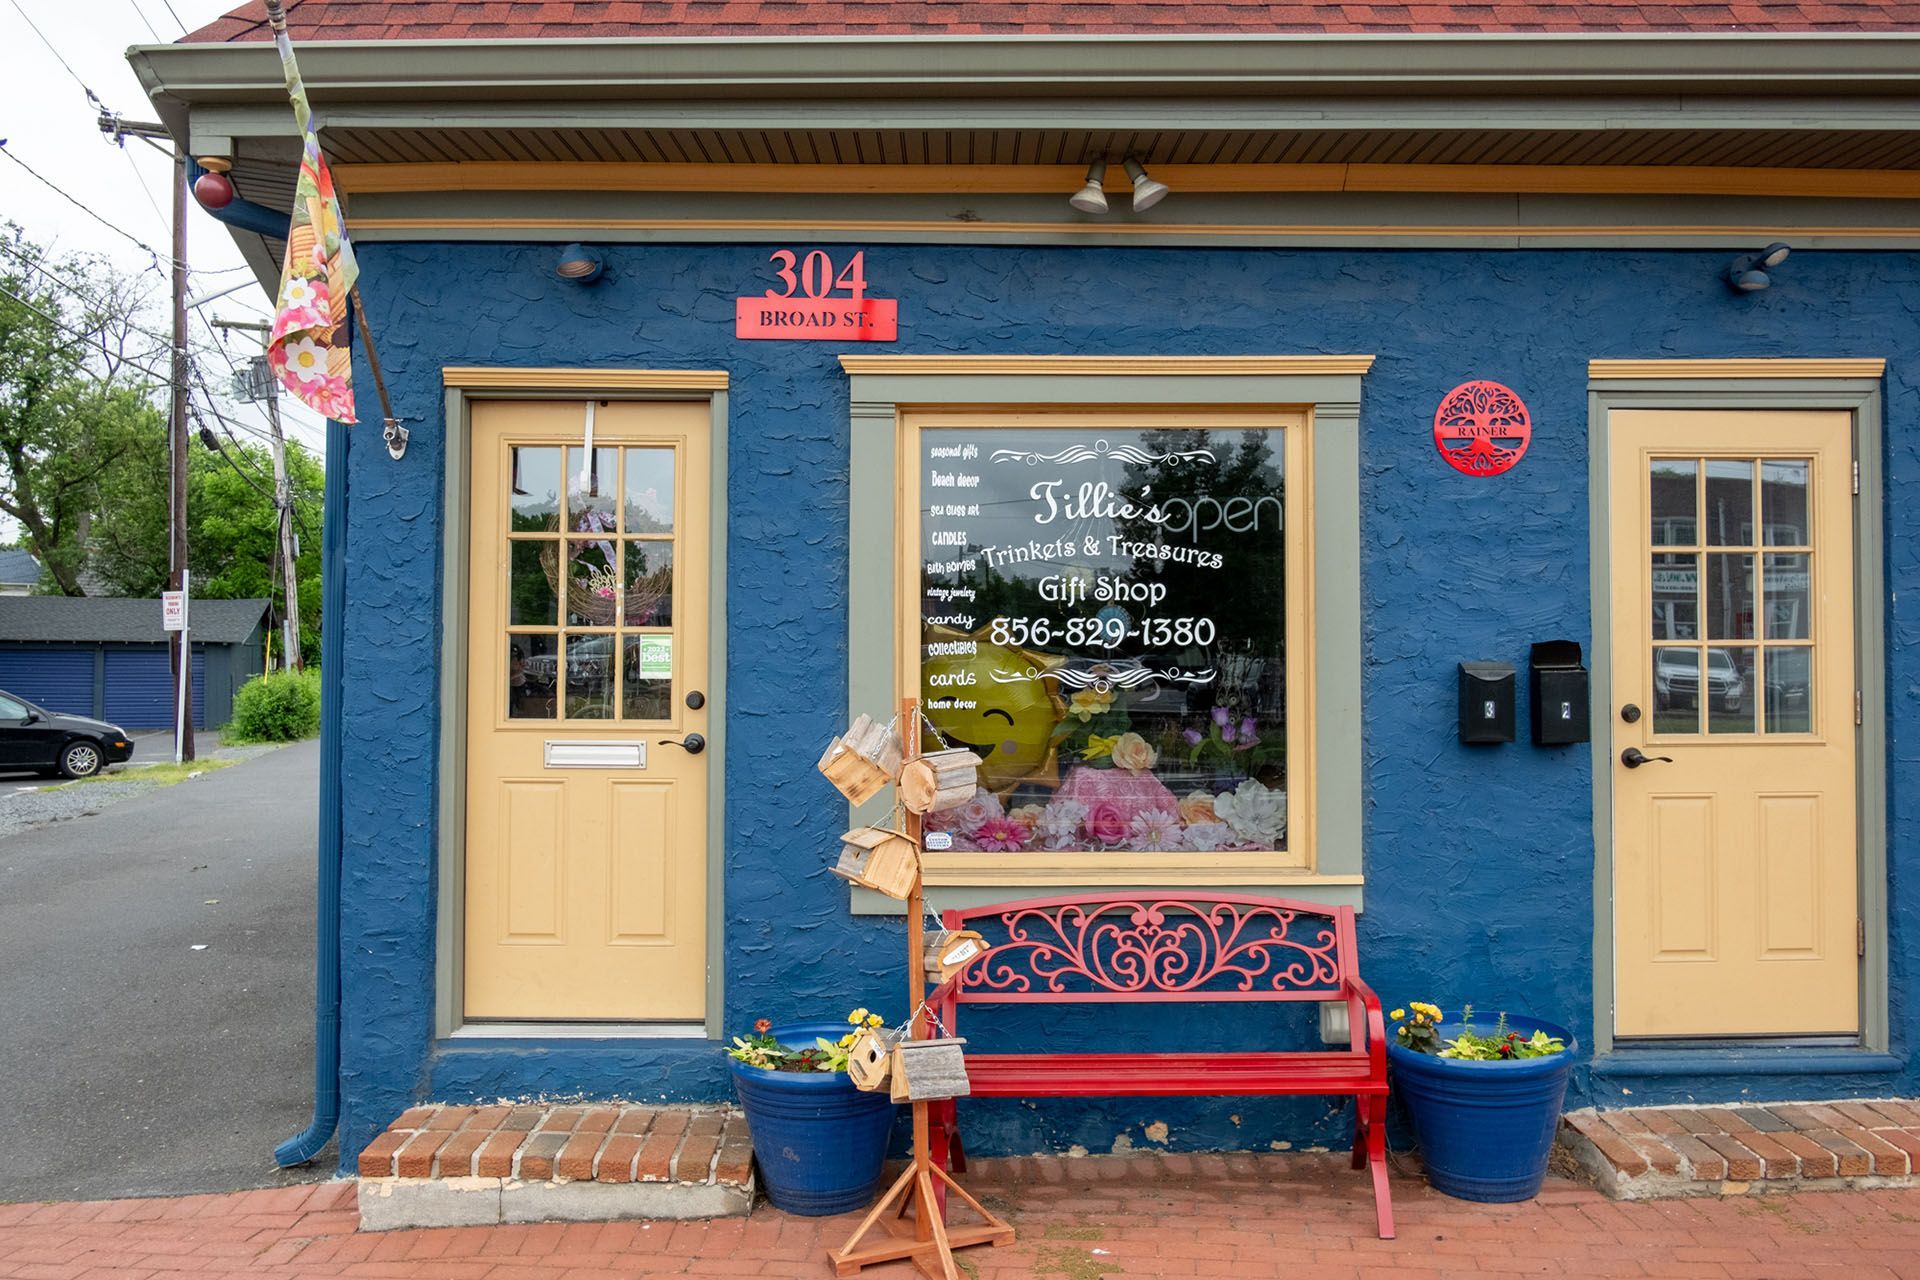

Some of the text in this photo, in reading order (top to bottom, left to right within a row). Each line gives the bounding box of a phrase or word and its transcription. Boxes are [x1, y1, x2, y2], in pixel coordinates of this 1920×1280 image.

[765, 249, 868, 299] 304
[760, 310, 874, 328] BROAD ST.
[1458, 427, 1508, 437] RAINER
[930, 443, 978, 461] seasonal gifts
[931, 470, 980, 488] Beach decor
[1030, 478, 1172, 525] Tillie's
[1161, 497, 1283, 544] open
[932, 531, 967, 546] CANDLES
[980, 535, 1224, 570] Trinkets & Treasures
[1038, 575, 1168, 608] Gift Shop
[927, 612, 976, 630] candy
[990, 616, 1216, 649] 856-829-1380
[929, 669, 977, 686] cards
[927, 698, 977, 709] home decor
[1485, 701, 1495, 719] 3
[1561, 702, 1571, 719] 2
